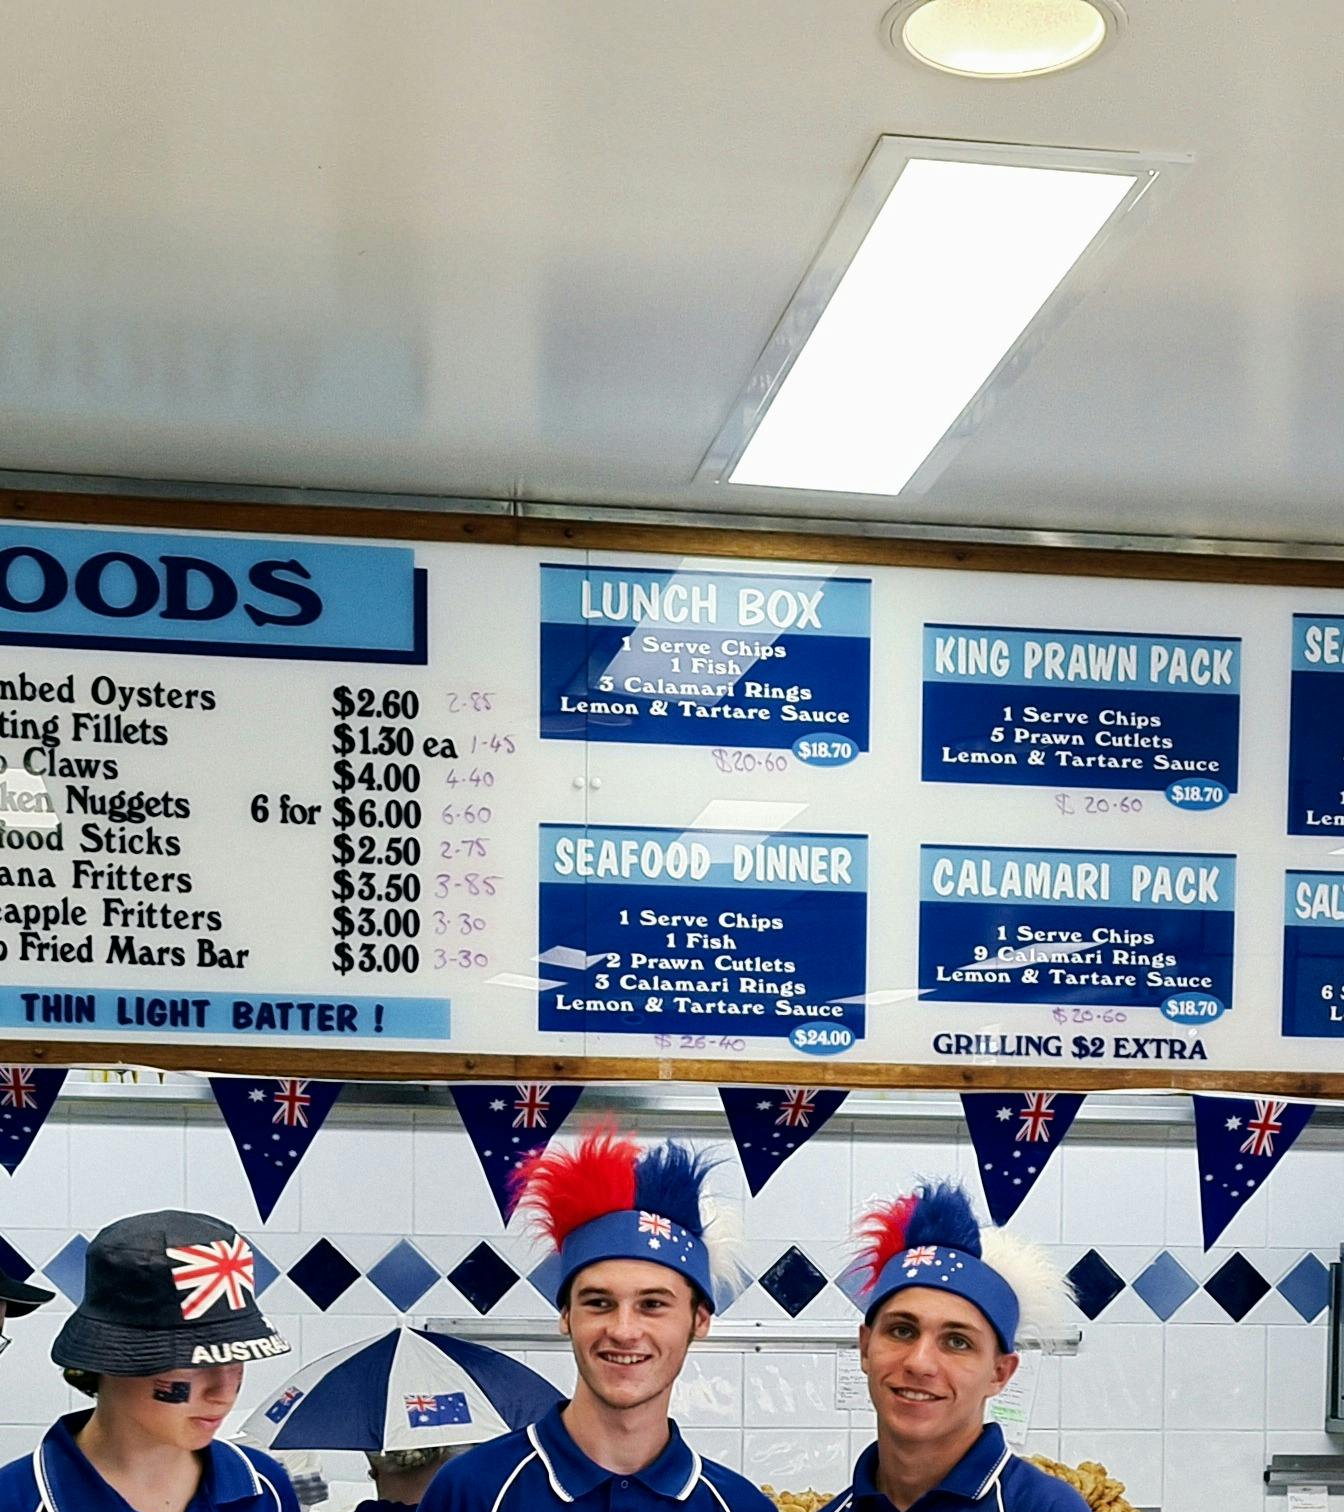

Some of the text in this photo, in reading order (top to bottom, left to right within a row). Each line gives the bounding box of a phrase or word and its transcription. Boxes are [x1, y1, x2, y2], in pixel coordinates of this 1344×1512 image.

[581, 581, 824, 629] LUNCH BOX
[622, 636, 786, 659] 1 Serve Chips
[672, 658, 742, 674] 1 Fish
[935, 636, 1232, 686] KING PRAWN PACK
[91, 676, 215, 711] Oysters
[332, 686, 419, 720] $2.60
[599, 676, 811, 702] 3 Calamari Rings
[561, 697, 849, 723] Lemon & Tartare Sauce
[72, 713, 168, 745] Fillets
[333, 723, 413, 757] $1.30
[423, 731, 458, 761] ea
[798, 741, 851, 760] $18.70
[1171, 785, 1223, 803] $18.70
[555, 837, 852, 885] SEAFOOD DINNER
[932, 859, 1219, 903] CALAMARI PACK
[20, 993, 96, 1024] THIN
[117, 997, 211, 1028] LIGHT
[232, 1001, 358, 1032] BATTER
[374, 1004, 384, 1033] !
[1166, 1000, 1217, 1017] $18.70
[794, 1029, 851, 1047] $24.00
[933, 1034, 1207, 1060] GRILLING $2 EXTRA
